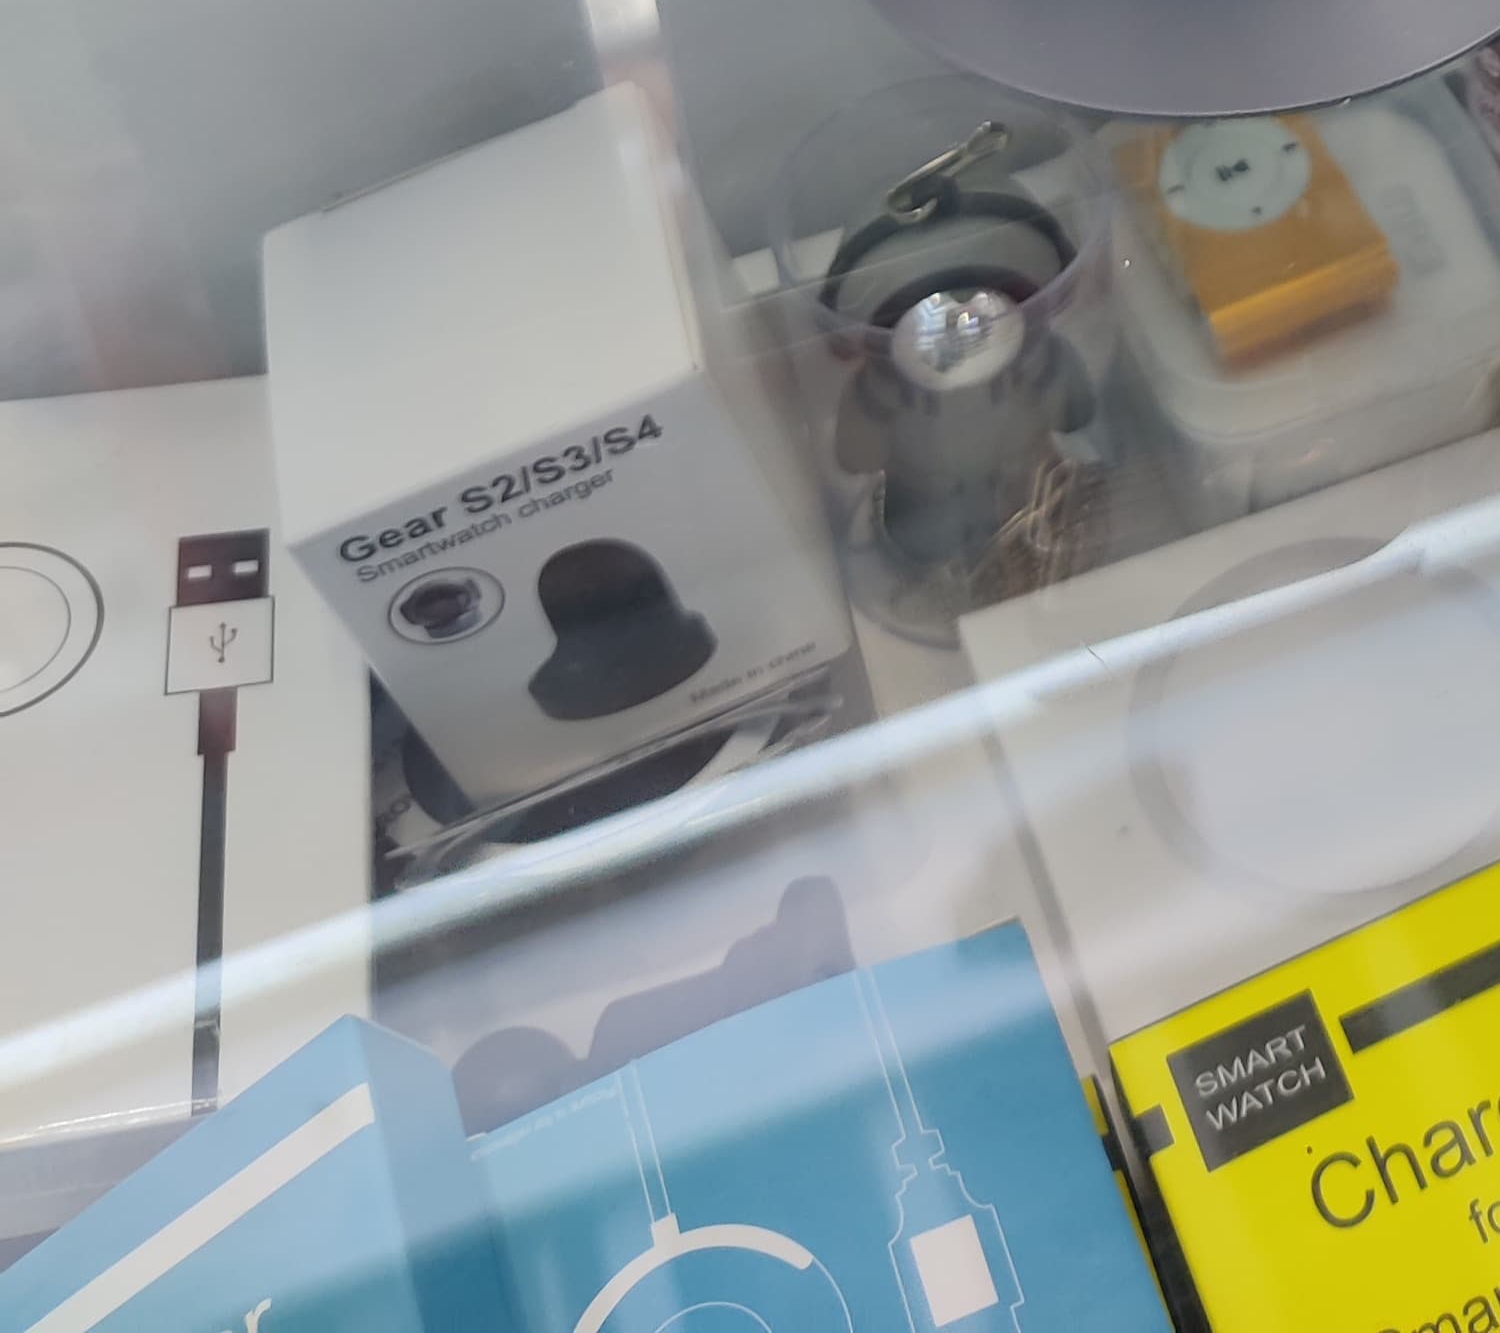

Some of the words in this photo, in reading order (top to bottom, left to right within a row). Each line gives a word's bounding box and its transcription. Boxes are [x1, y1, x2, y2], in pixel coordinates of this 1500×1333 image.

[339, 506, 449, 563] Gear
[460, 414, 664, 514] S2/S3/S4
[356, 511, 513, 584] Smartwatch
[518, 468, 615, 519] charger
[1194, 1024, 1306, 1098] SMART
[1206, 1056, 1327, 1131] WATCH
